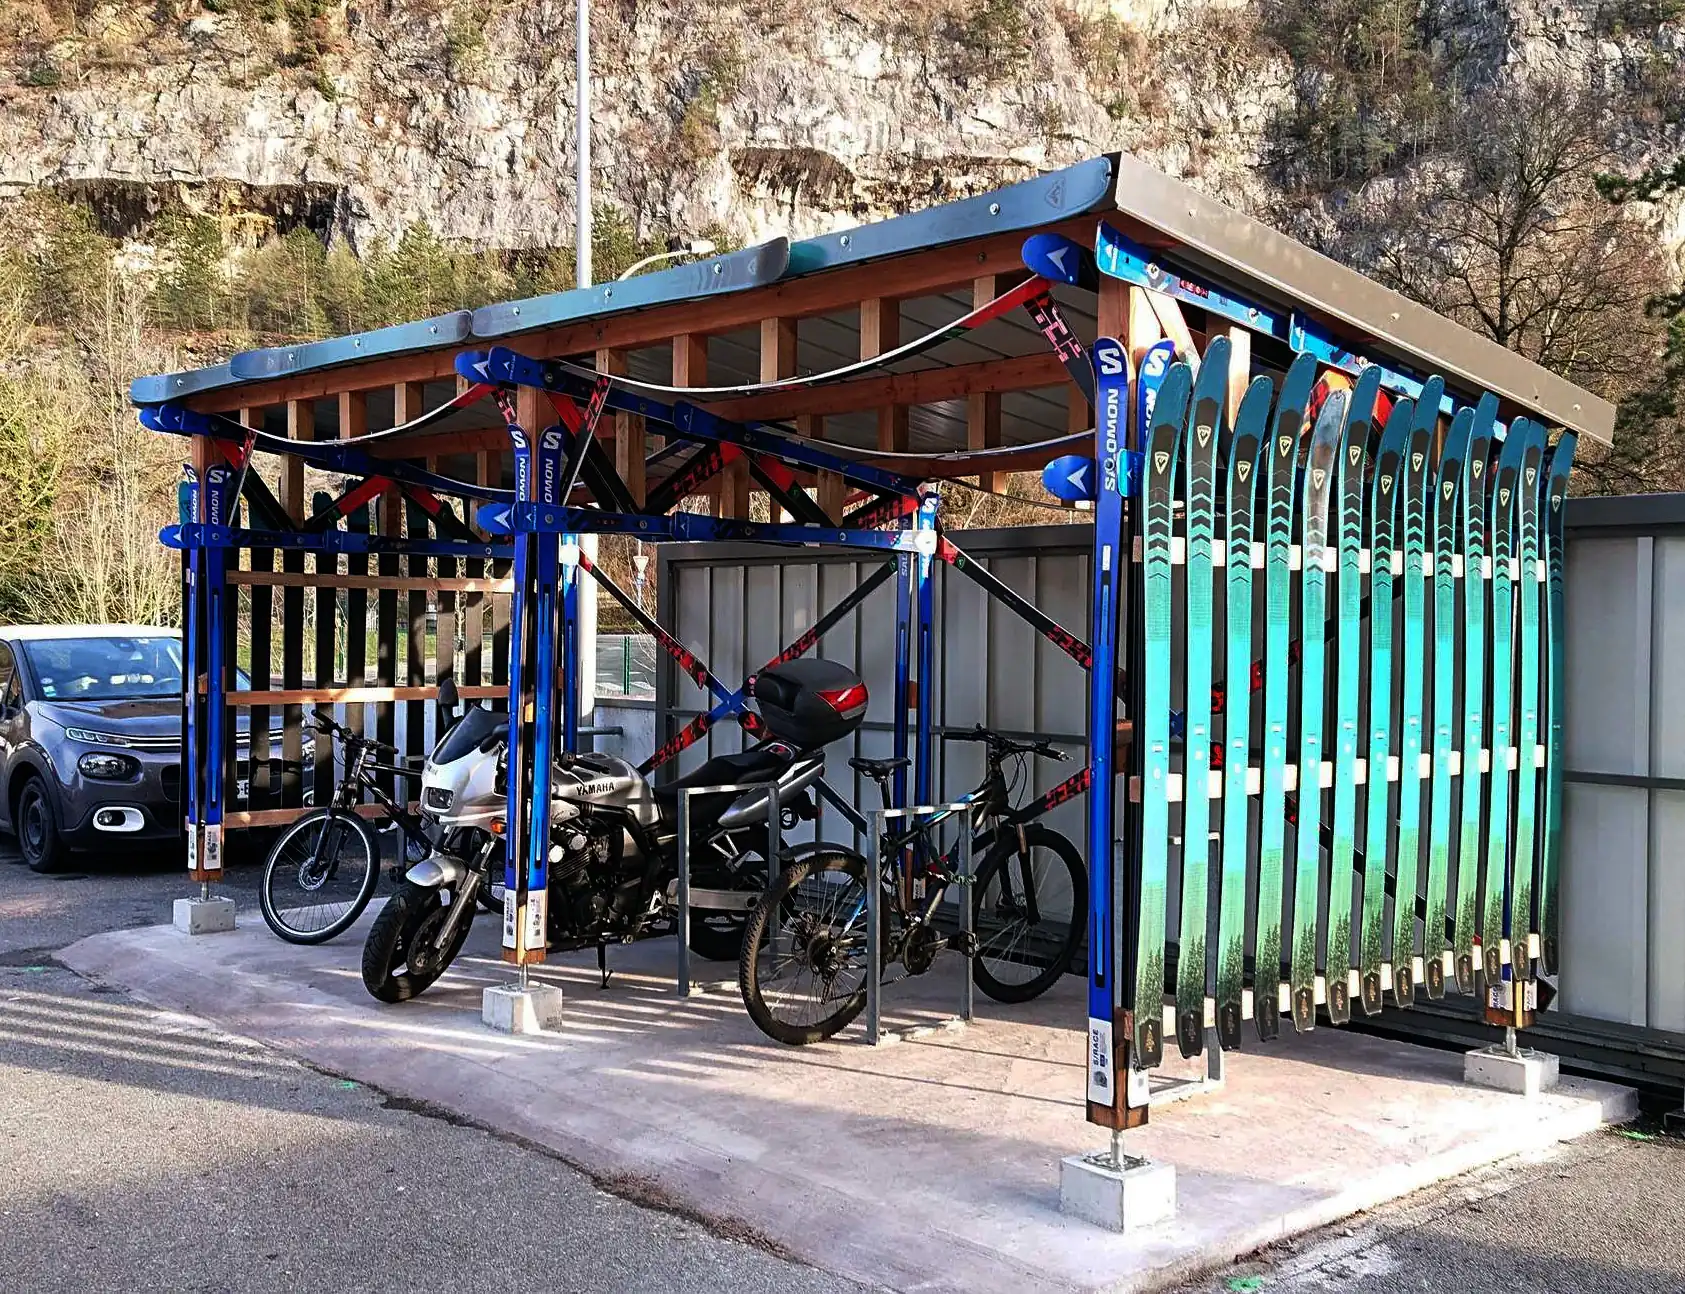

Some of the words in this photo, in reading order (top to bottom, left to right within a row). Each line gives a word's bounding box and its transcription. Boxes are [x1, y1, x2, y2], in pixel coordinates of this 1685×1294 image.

[1104, 388, 1119, 492] SOMON
[576, 781, 616, 797] YAMAHA
[1092, 1029, 1100, 1066] S/RACE
